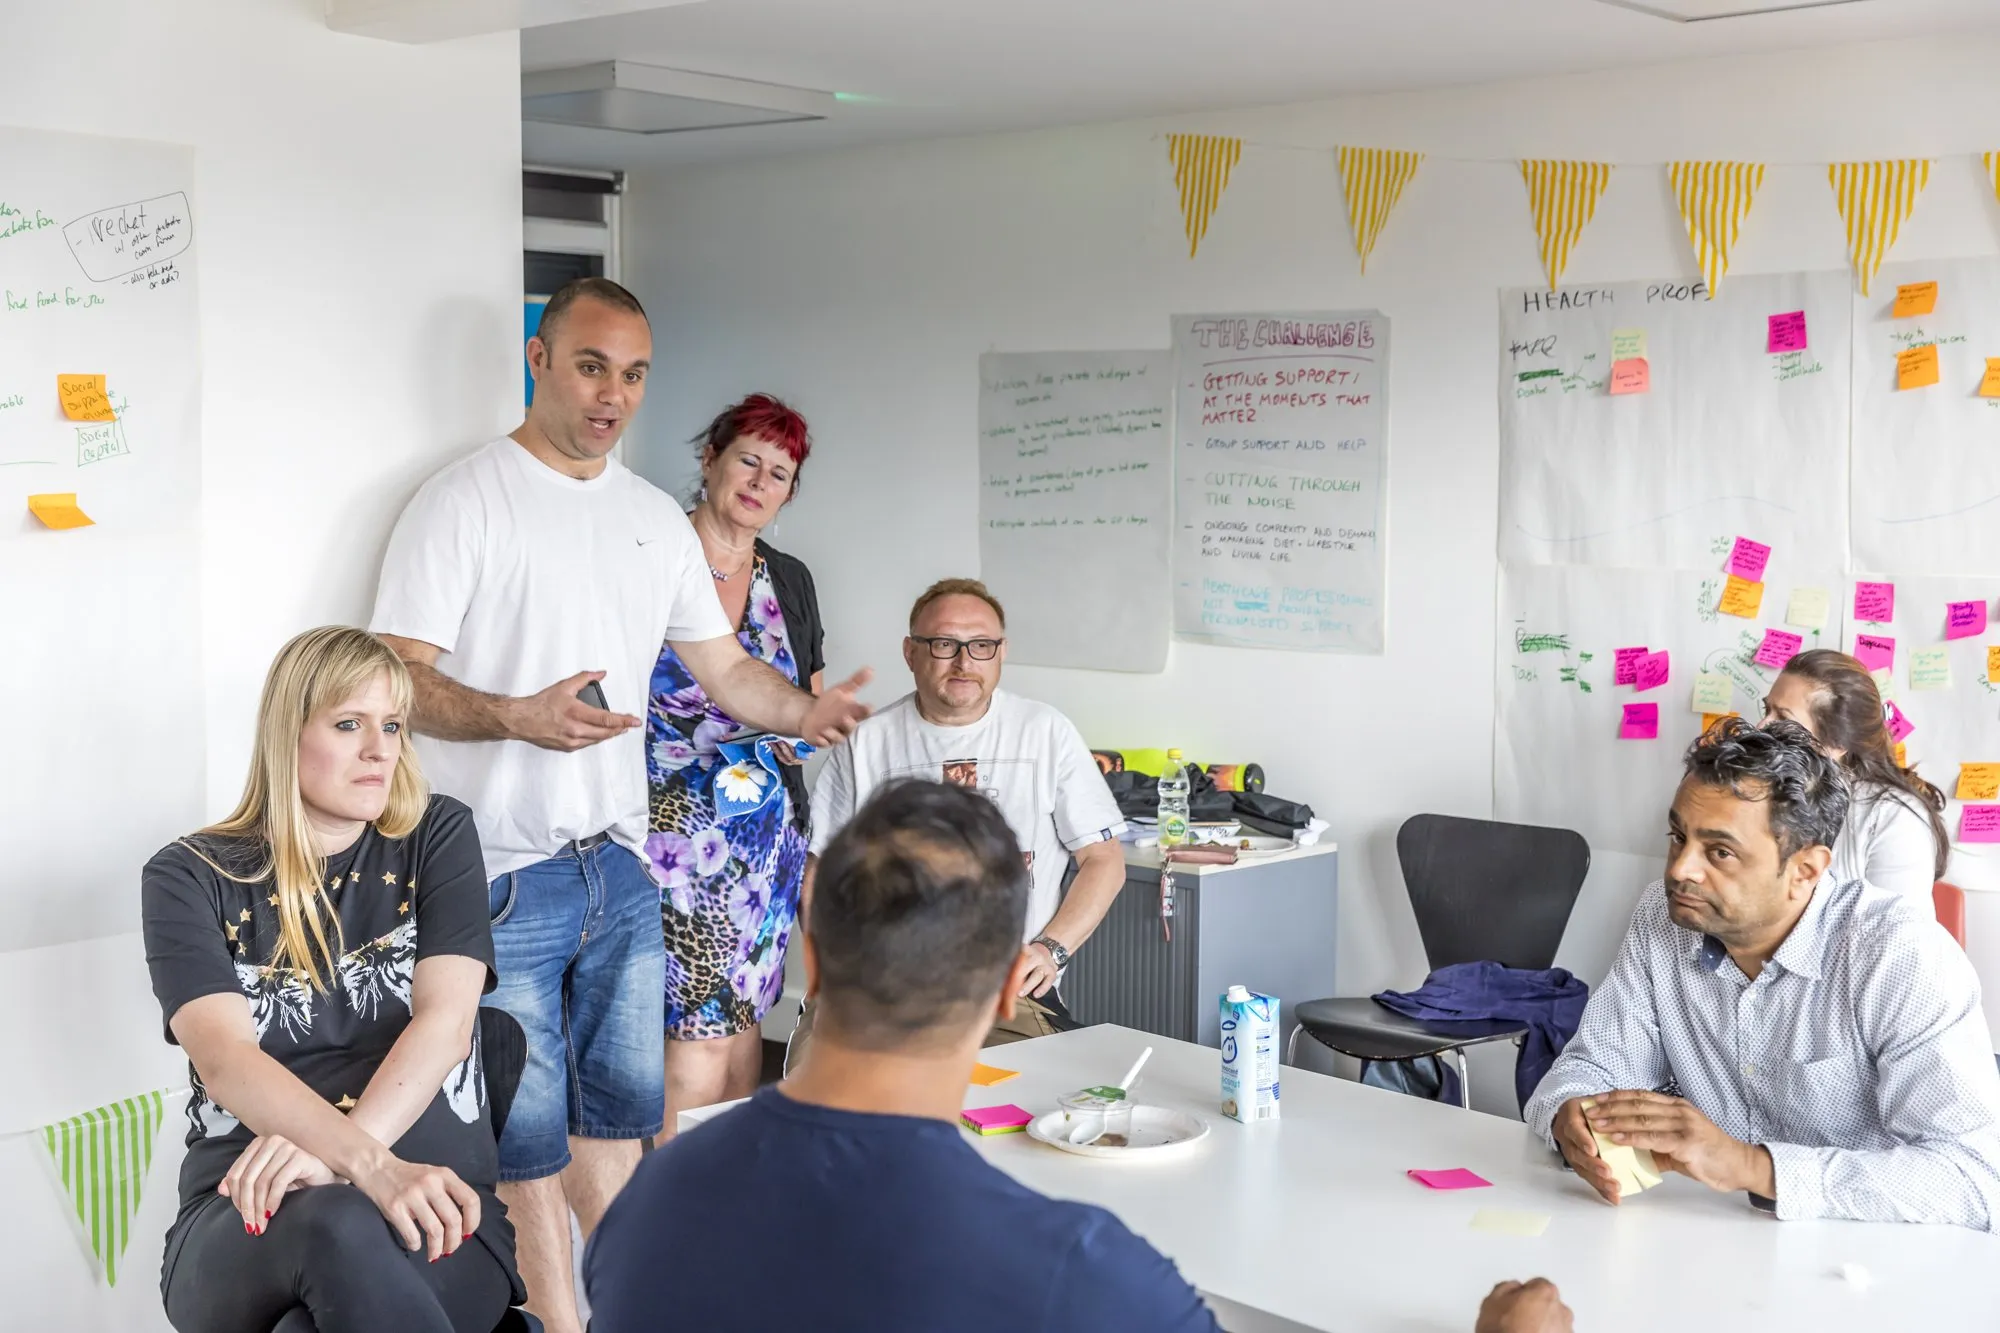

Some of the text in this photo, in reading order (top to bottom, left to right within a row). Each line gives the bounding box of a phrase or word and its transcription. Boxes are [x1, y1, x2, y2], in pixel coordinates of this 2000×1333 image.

[118, 204, 147, 234] chat
[1523, 289, 1615, 314] HEALTH
[1191, 319, 1375, 350] THE CHALLENGE
[61, 376, 97, 397] Social
[1203, 371, 1269, 392] GETTING
[1203, 392, 1370, 408] AT THE MOMENTS THAT
[1205, 439, 1368, 451] GROUP SUPPORT AND HELP
[1204, 472, 1362, 492] CUTTING THROUGH
[1205, 493, 1296, 510] THE NOISE
[1204, 521, 1249, 532] ONGOING
[1256, 521, 1306, 534] COMPLEXITY
[1314, 527, 1332, 537] AND
[1201, 534, 1356, 552] OF MANAGING DIET LIFESTYLE
[1201, 547, 1292, 563] AND LIVING LIFE
